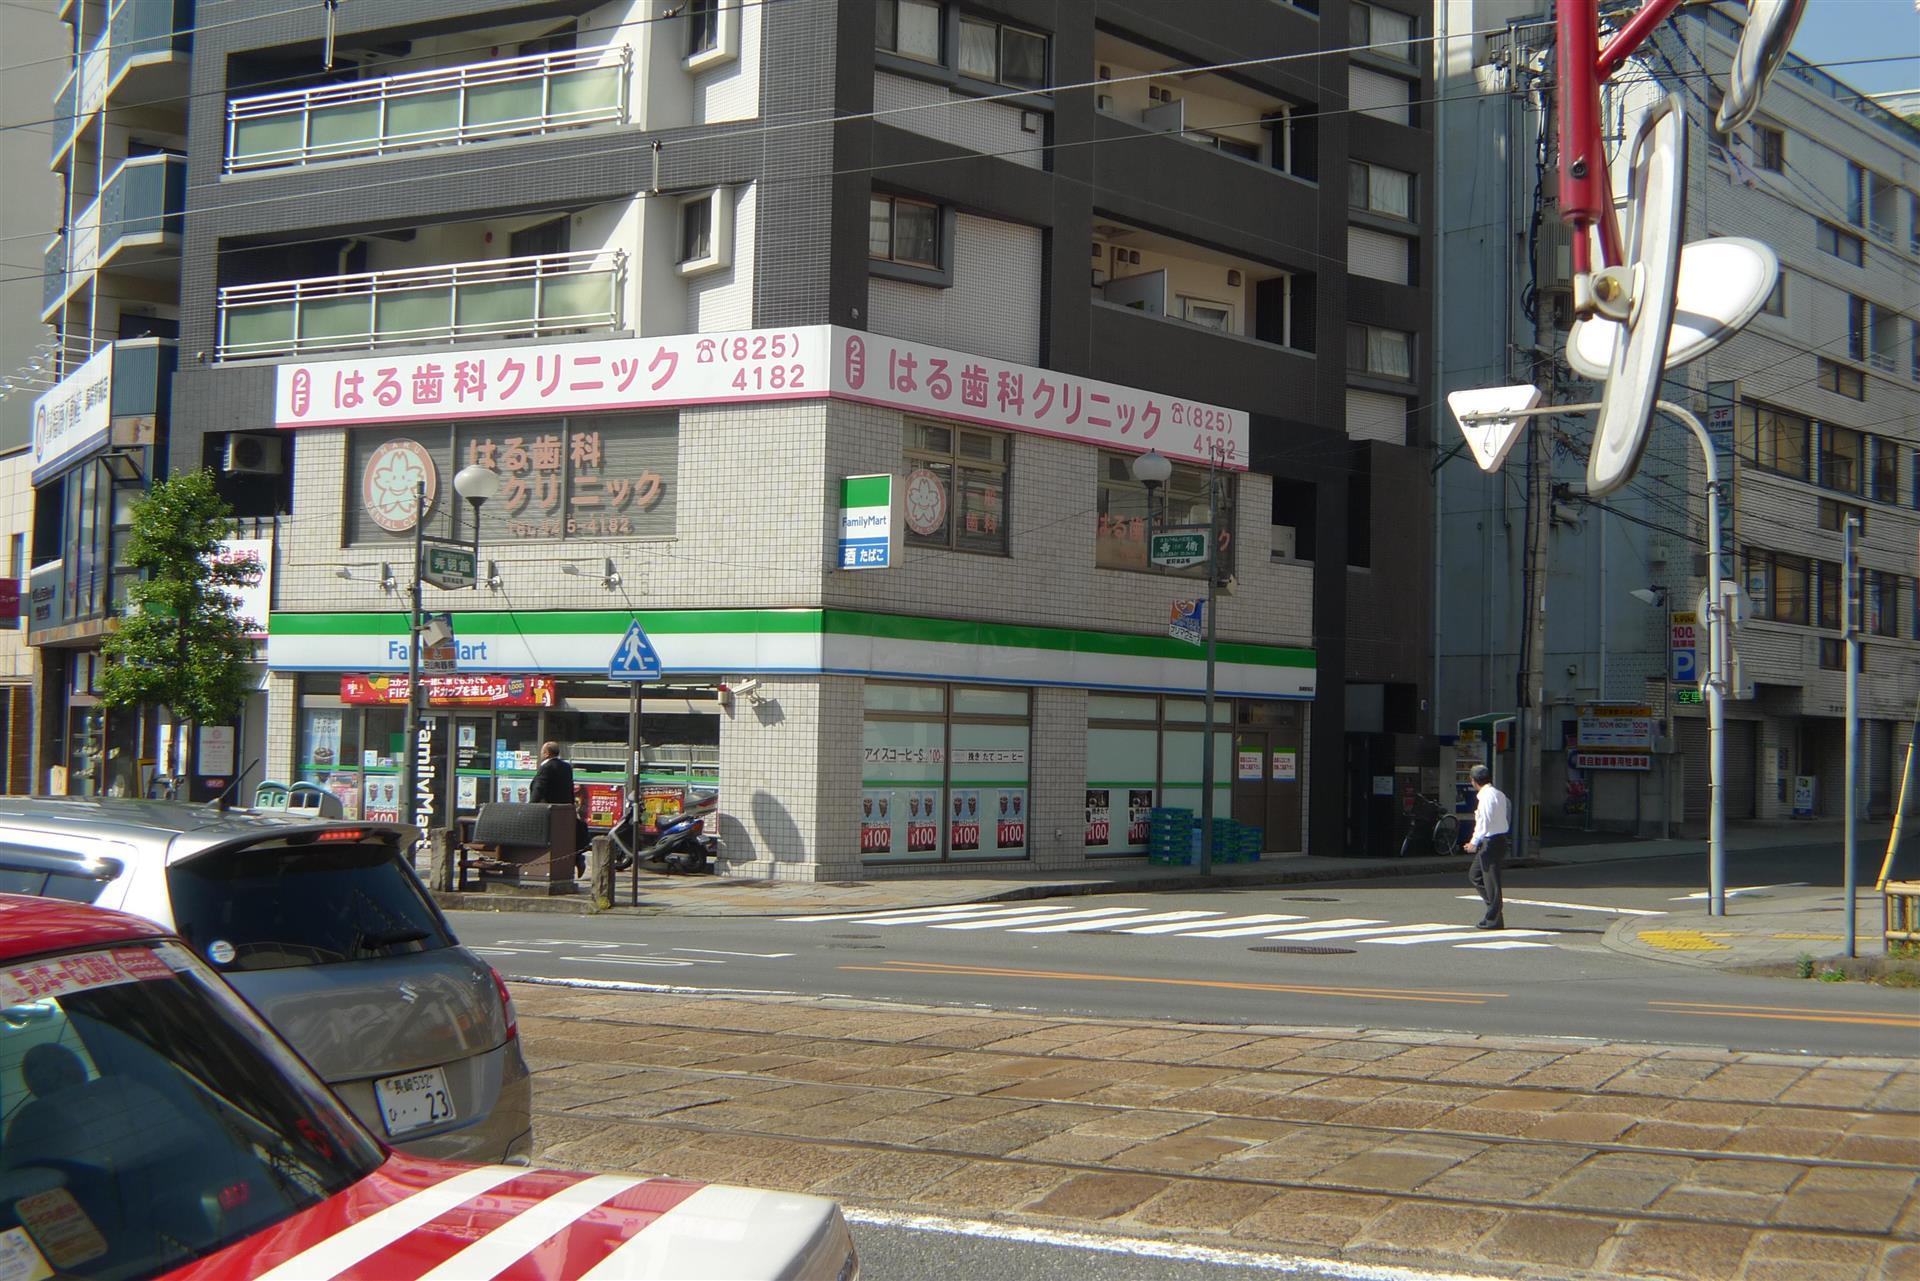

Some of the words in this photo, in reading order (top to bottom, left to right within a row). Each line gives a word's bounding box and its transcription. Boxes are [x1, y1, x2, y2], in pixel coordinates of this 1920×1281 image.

[721, 333, 800, 363] (825)
[335, 346, 679, 409] はる歯科クリニック
[731, 364, 806, 391] 4182
[888, 348, 1161, 440] はる歯科クリニック
[1186, 405, 1233, 434] (825)
[470, 431, 601, 471] はる歯科
[1193, 434, 1236, 460] 4182
[503, 470, 661, 511] クリニック
[842, 515, 887, 529] FamilyMart
[859, 548, 884, 564] たばこ
[1673, 651, 1694, 679] P
[425, 1089, 449, 1120] 23
